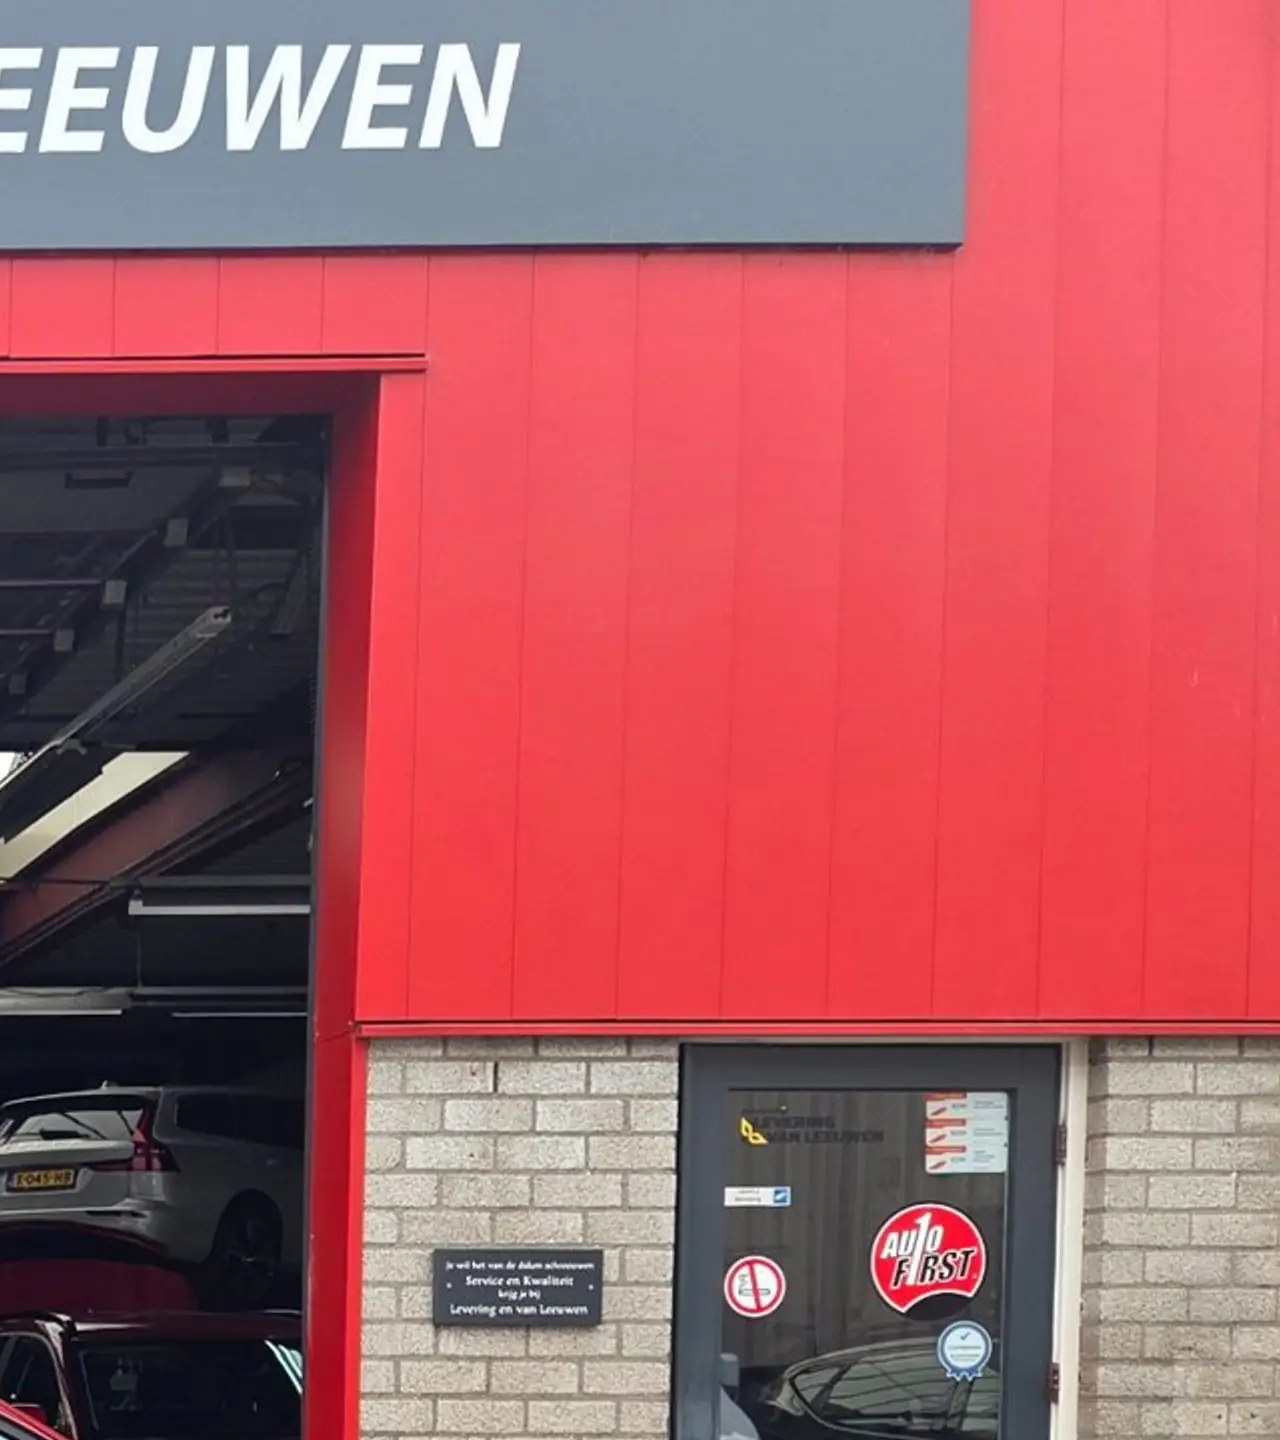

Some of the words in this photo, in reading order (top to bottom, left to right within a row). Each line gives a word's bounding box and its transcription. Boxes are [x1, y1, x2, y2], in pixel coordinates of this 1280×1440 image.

[465, 1275, 504, 1286] Service
[506, 1277, 521, 1286] en
[523, 1274, 574, 1287] Kwaliteit
[449, 1303, 497, 1318] Levering
[498, 1306, 514, 1315] en
[516, 1306, 537, 1315] van
[539, 1303, 589, 1316] Leeuwen
